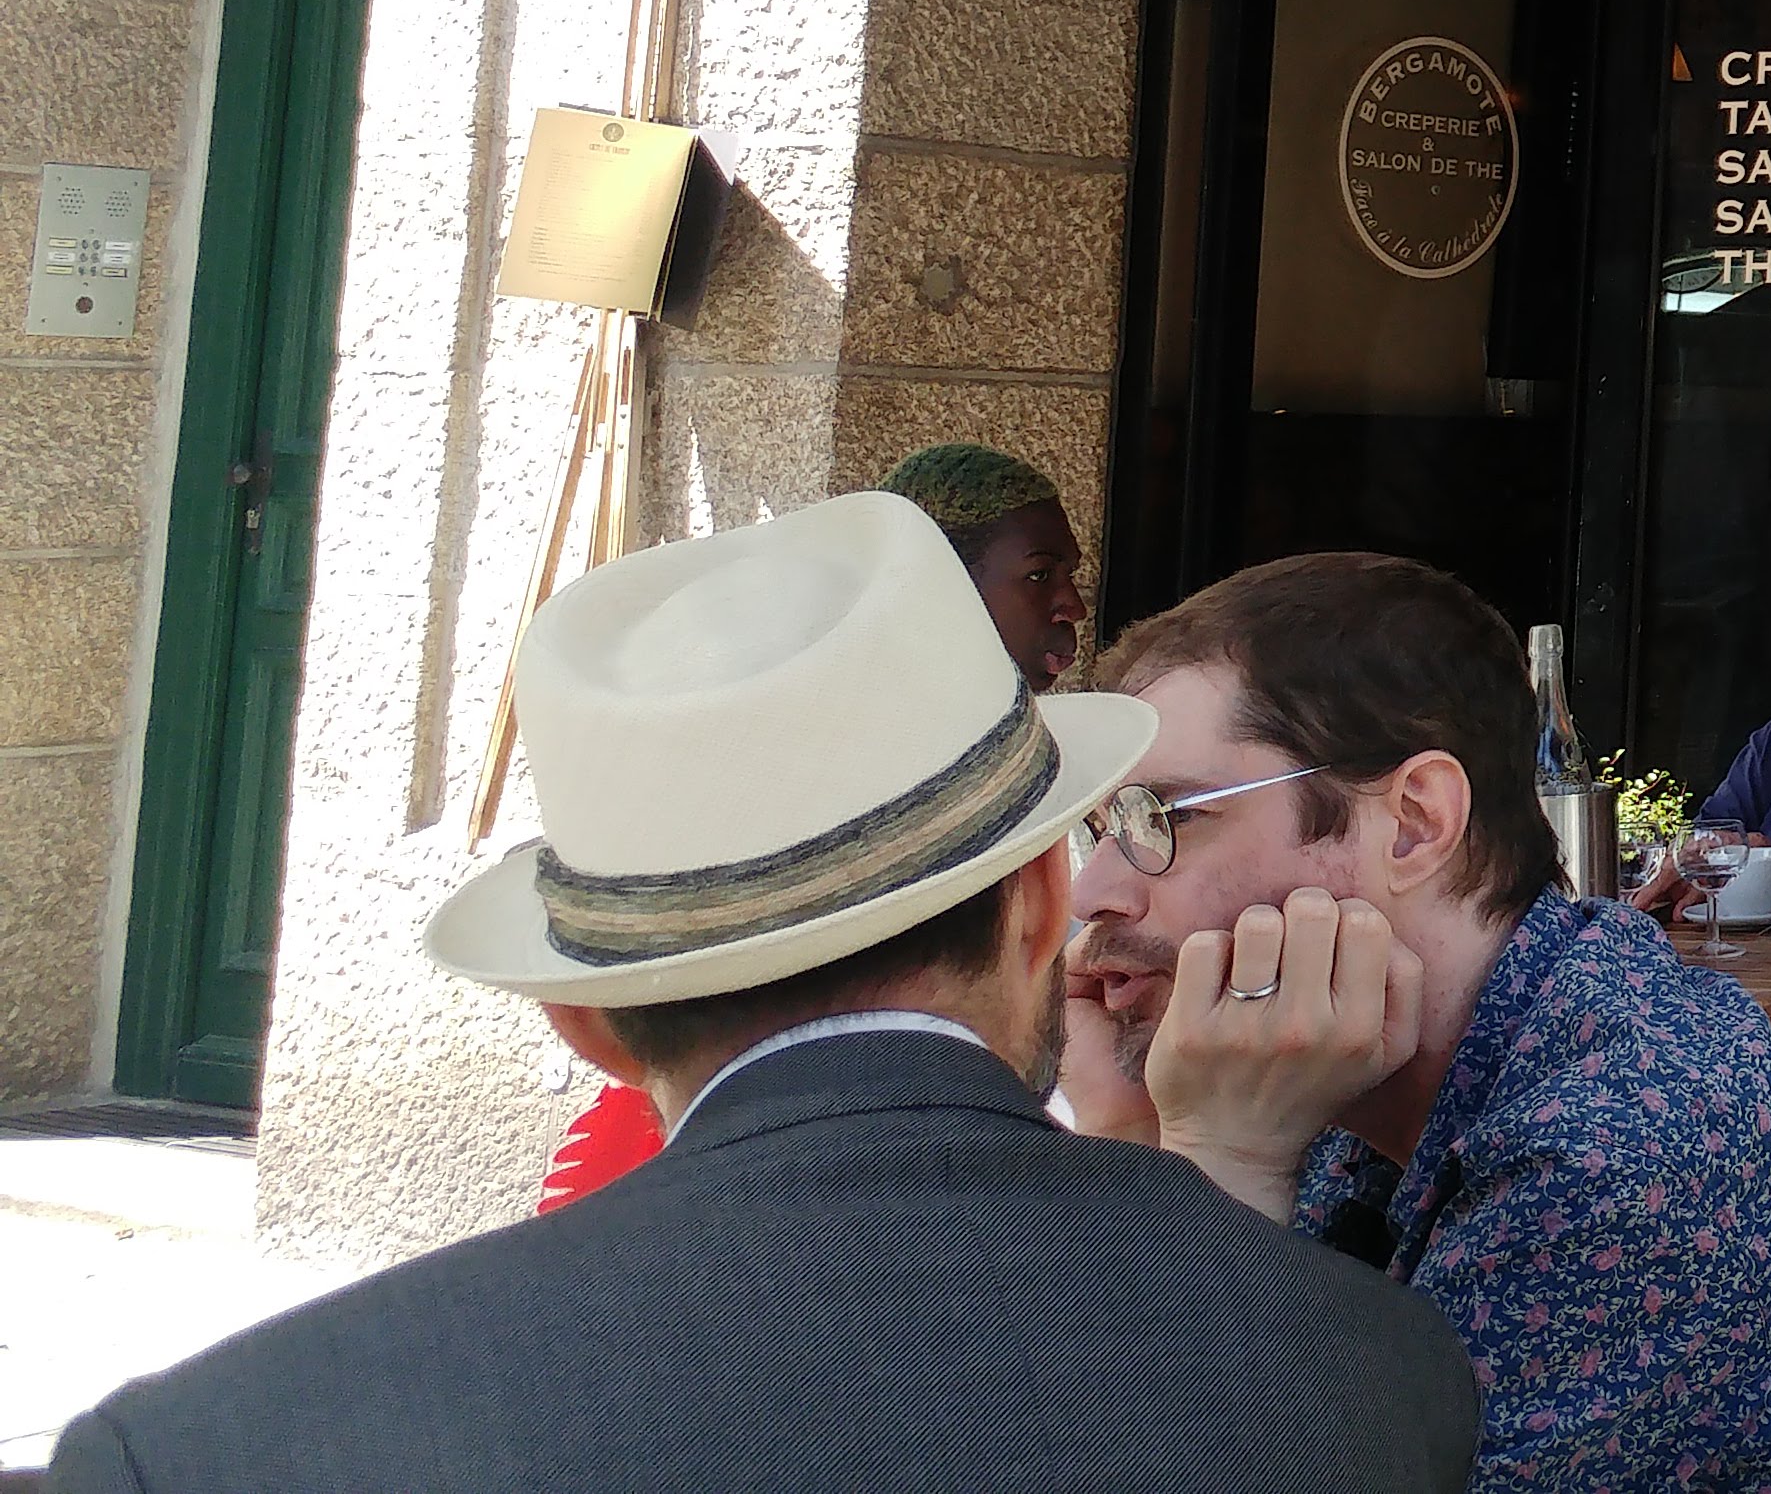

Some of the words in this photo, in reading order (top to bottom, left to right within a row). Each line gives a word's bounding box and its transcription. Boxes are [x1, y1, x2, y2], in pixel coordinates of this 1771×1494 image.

[1359, 52, 1502, 136] BERGAMOTE
[1381, 111, 1480, 136] CREPERIE
[1422, 138, 1435, 152] &
[1351, 149, 1422, 173] SALON
[1431, 158, 1458, 175] DE
[1465, 161, 1503, 180] THE
[1350, 177, 1379, 227] Face
[1391, 235, 1413, 260] la
[1418, 193, 1503, 264] Cathédrale
